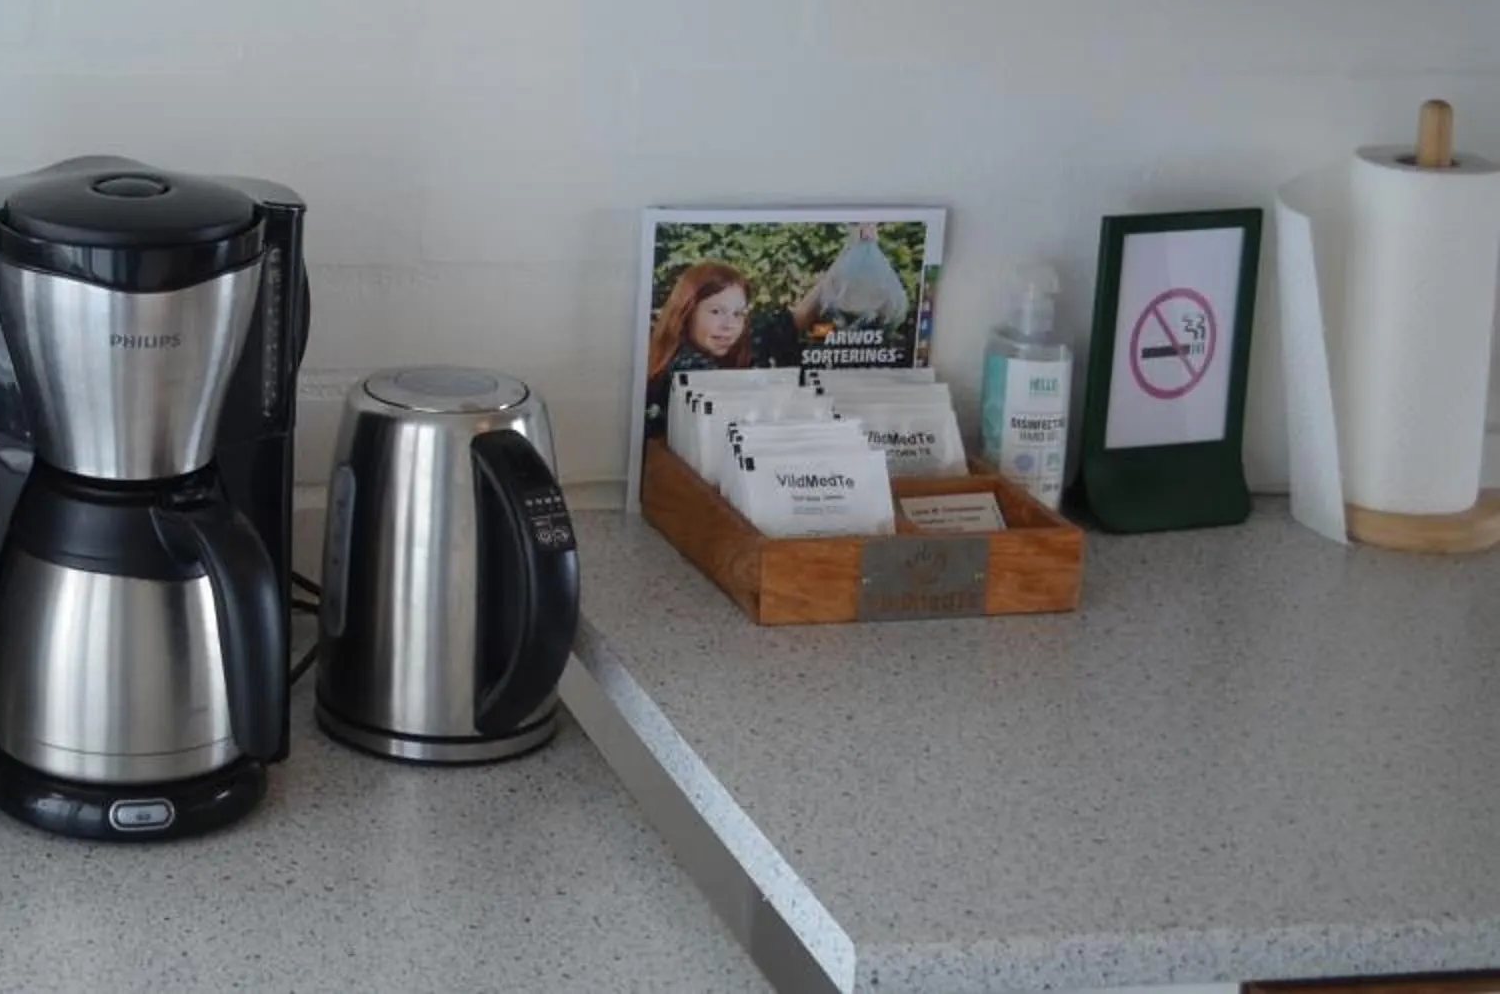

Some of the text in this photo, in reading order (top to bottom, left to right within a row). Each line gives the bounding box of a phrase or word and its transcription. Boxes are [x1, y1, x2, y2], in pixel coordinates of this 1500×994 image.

[110, 333, 181, 348] PHILIPS
[824, 329, 884, 346] ARWOS
[801, 347, 905, 365] SORTERINGS-
